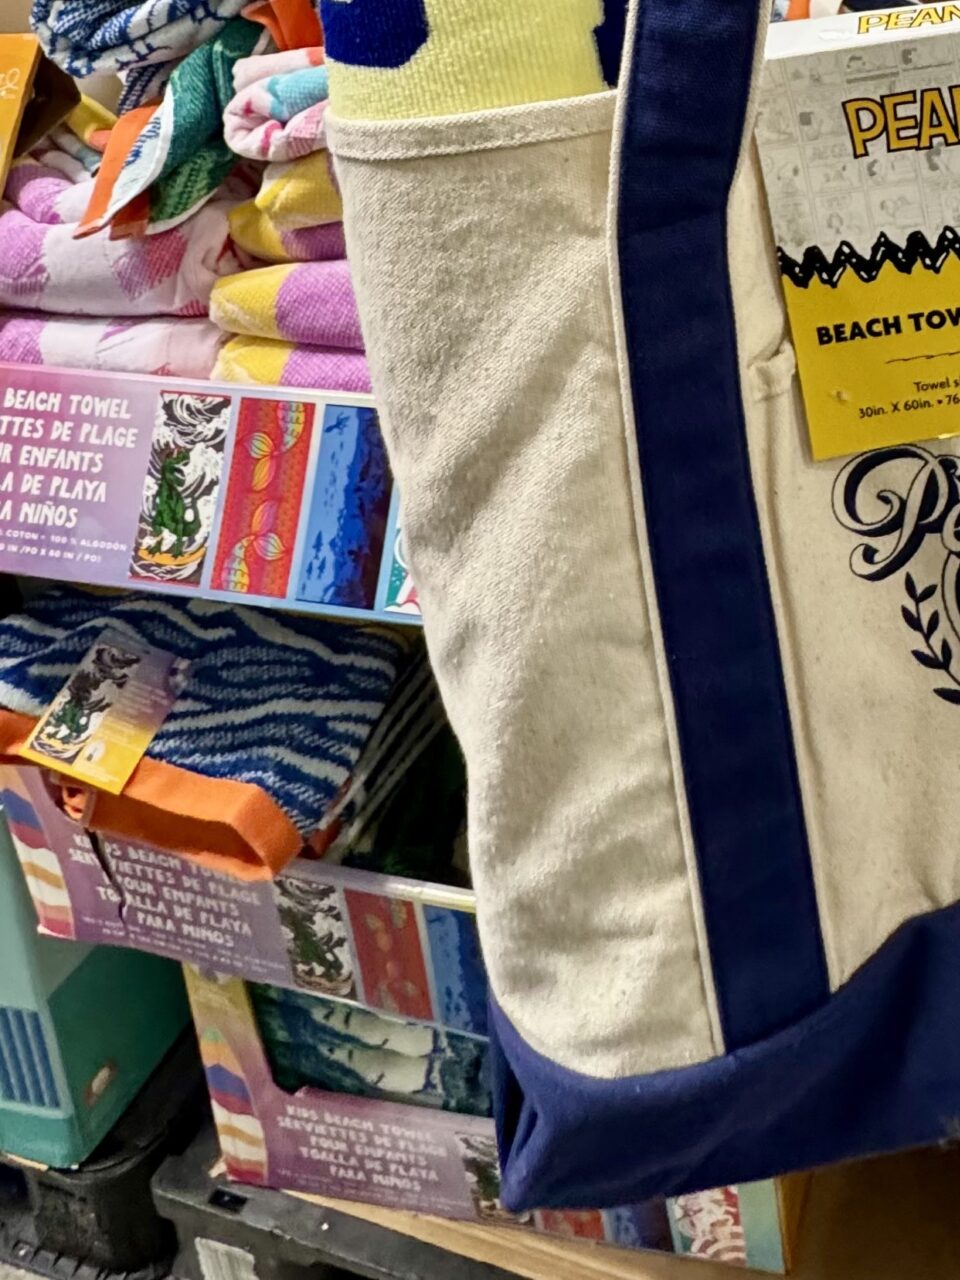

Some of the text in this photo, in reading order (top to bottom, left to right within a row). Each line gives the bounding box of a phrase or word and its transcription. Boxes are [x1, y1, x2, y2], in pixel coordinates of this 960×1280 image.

[816, 315, 902, 347] BEACH
[913, 377, 951, 393] Towel
[3, 387, 132, 419] BEACH TOWEL
[858, 405, 888, 419] 30in.
[891, 402, 900, 413] X
[903, 398, 934, 412] 60in.
[50, 420, 75, 442] DE
[79, 422, 138, 448] PLAGE
[19, 445, 104, 474] ENFANTS
[20, 473, 45, 495] DE
[49, 475, 107, 502] PLAYA
[19, 500, 79, 529] NIÑOS
[5, 528, 39, 540] COTON
[50, 533, 67, 544] 100
[127, 845, 183, 870] BEACH
[162, 885, 240, 918] ENFANTS
[182, 872, 202, 891] DE
[208, 880, 262, 906] PLAGE
[172, 904, 194, 921] DE
[200, 908, 252, 935] PLAYA
[276, 1114, 369, 1144] SERVIETTES
[373, 1135, 392, 1149] DE
[285, 1104, 433, 1141] KIDS BEACH TOWEL
